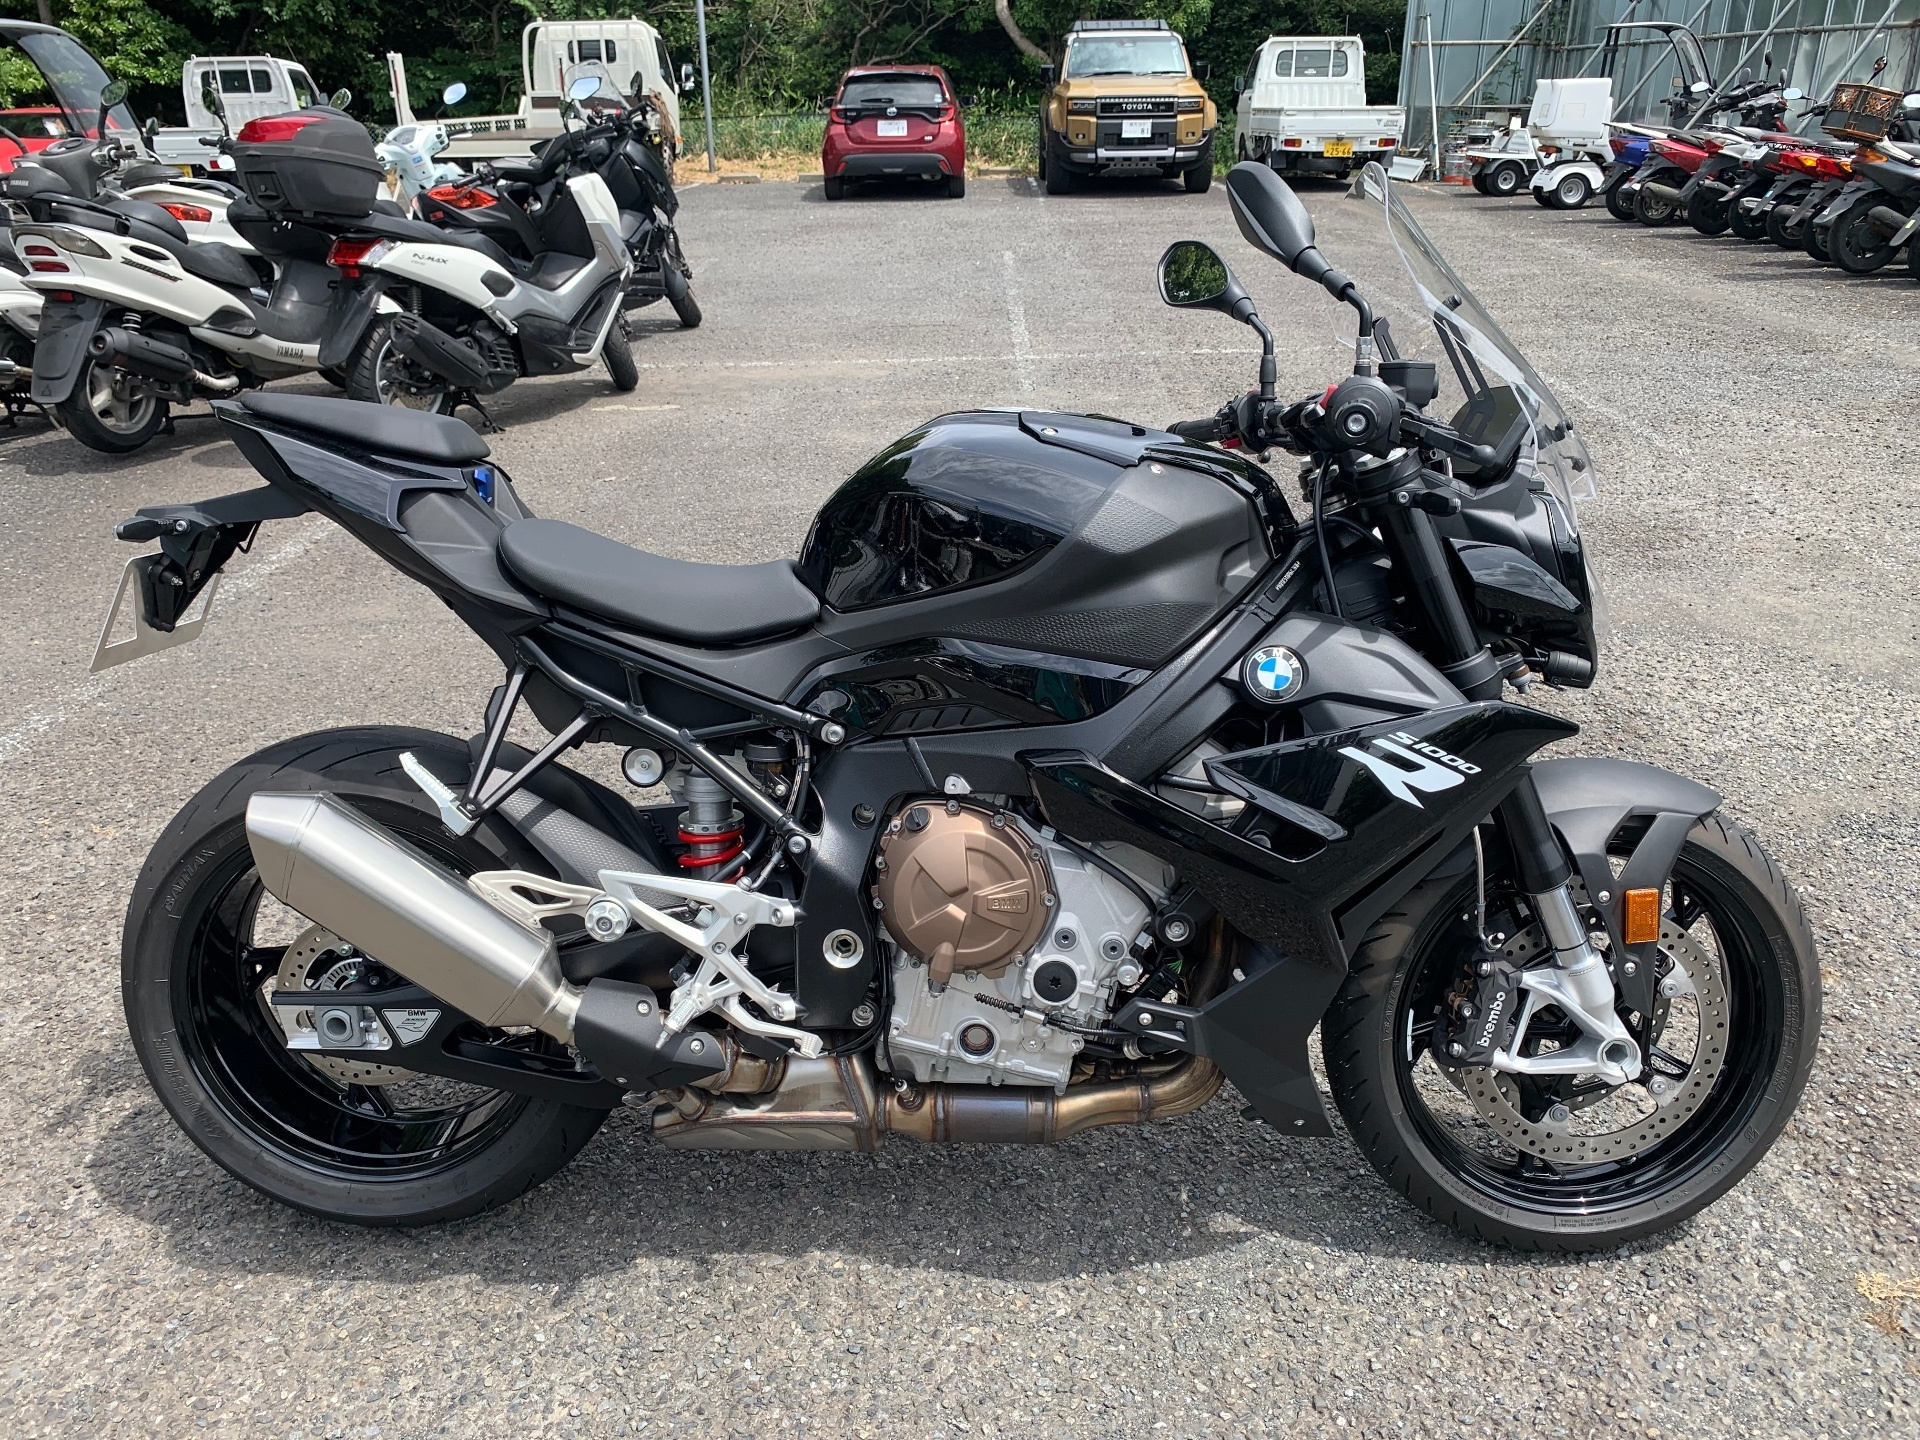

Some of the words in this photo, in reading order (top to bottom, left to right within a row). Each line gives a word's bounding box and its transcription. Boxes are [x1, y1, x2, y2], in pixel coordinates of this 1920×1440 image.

[276, 344, 304, 360] YAMAHA
[1253, 647, 1300, 669] BMW
[1387, 731, 1482, 775] S1000
[991, 898, 1024, 909] BMW
[407, 1009, 427, 1017] BMW
[1476, 990, 1507, 1048] brembo
